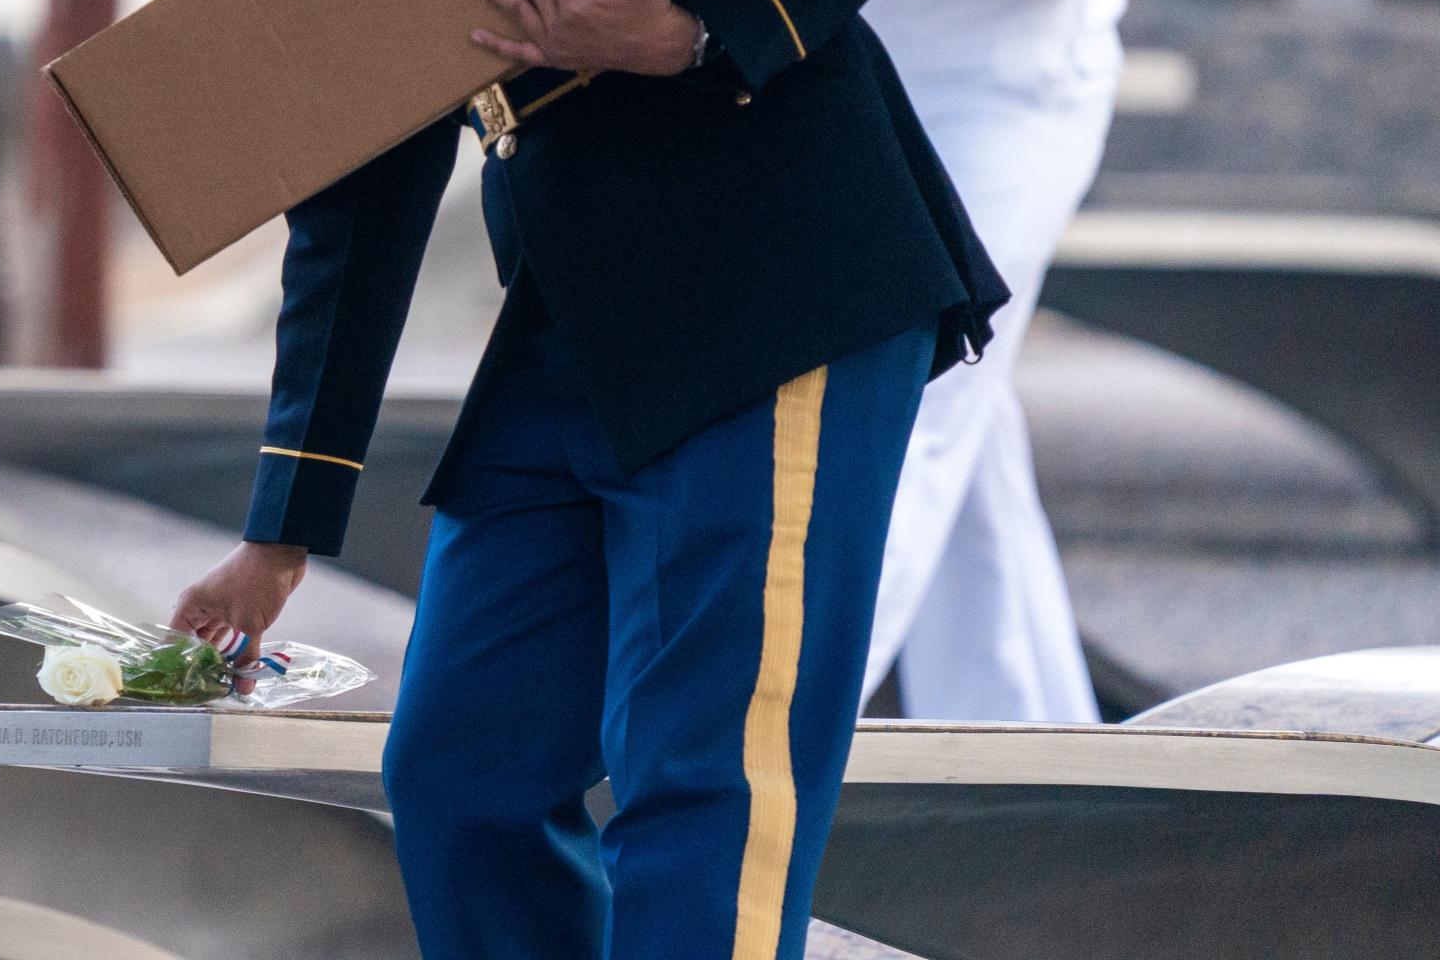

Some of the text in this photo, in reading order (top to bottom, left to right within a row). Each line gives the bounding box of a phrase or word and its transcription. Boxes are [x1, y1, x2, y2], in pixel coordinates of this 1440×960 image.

[14, 728, 27, 744] D.
[32, 729, 113, 748] RATCHFORD,
[116, 730, 143, 747] USN
